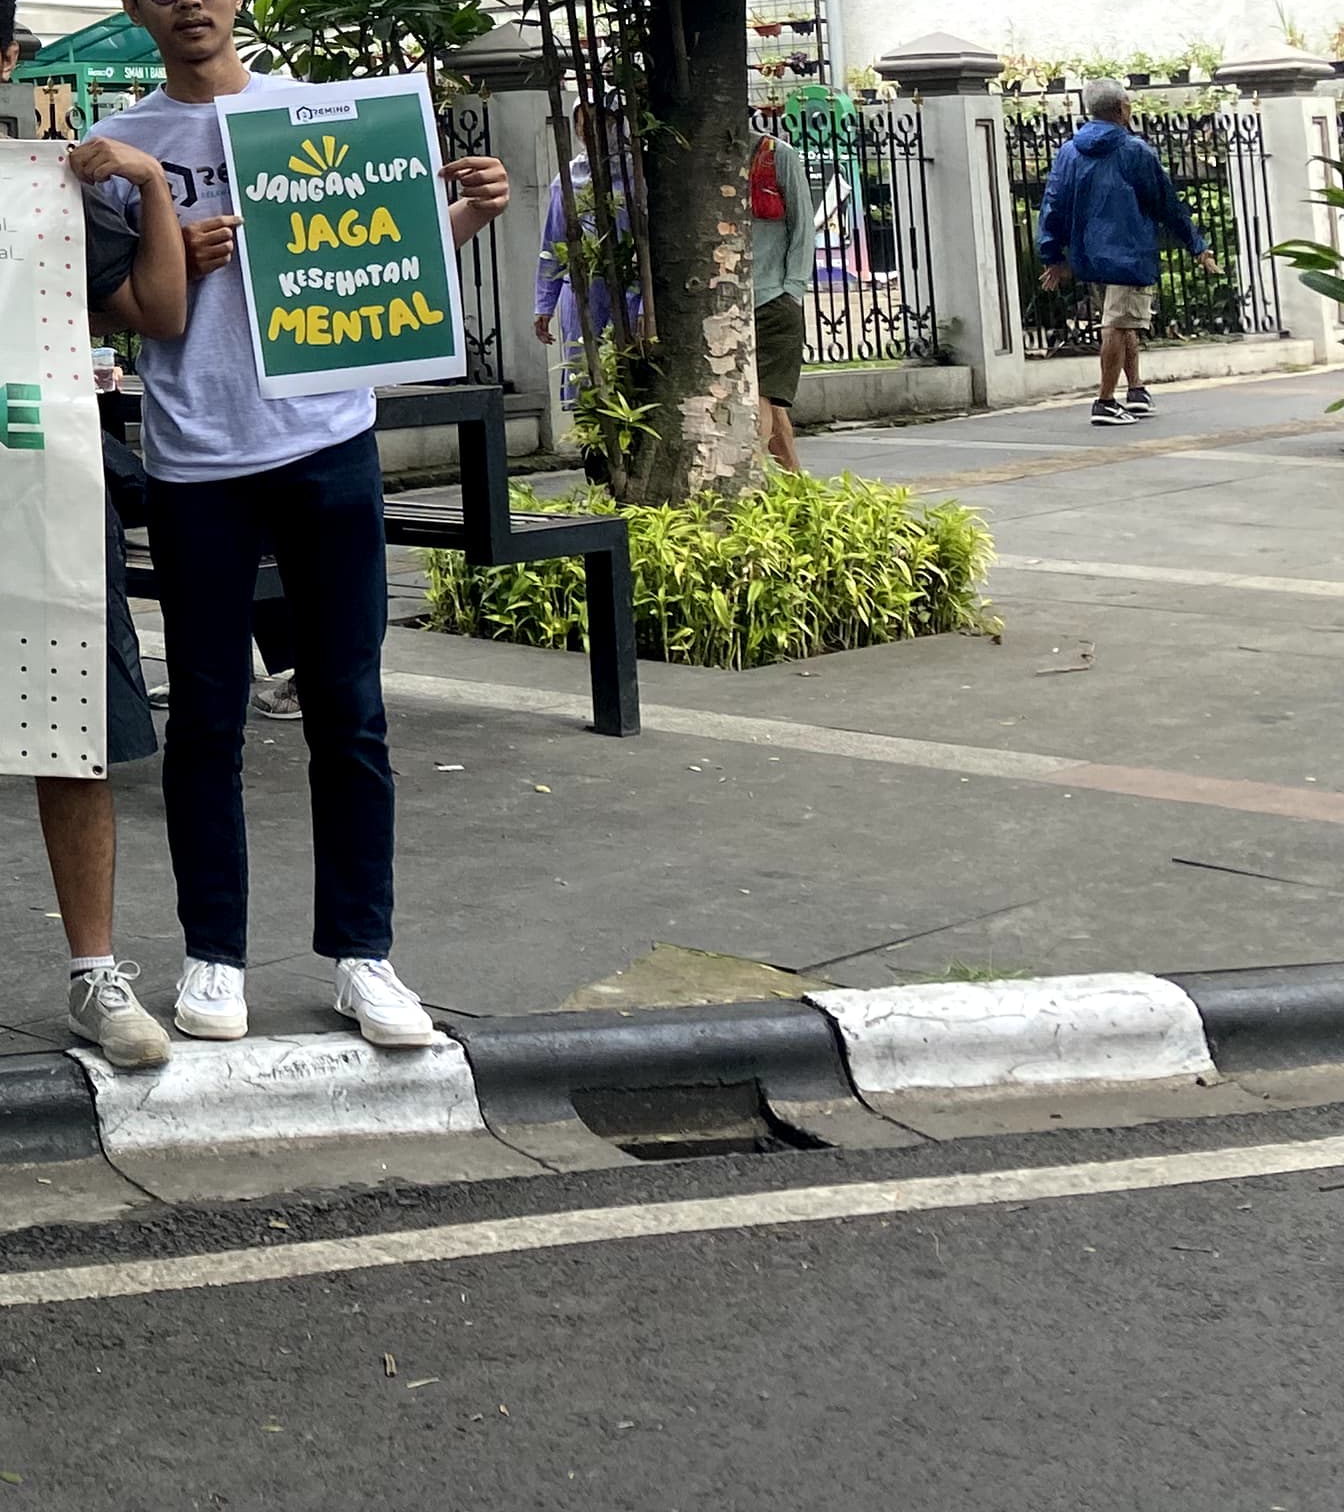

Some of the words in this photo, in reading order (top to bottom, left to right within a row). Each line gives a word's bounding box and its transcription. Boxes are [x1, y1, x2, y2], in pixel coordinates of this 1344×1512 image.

[245, 171, 366, 203] JANGAN
[365, 156, 428, 183] LUPA
[287, 206, 401, 254] JAGA
[278, 256, 420, 297] KESEHATAN
[267, 291, 443, 345] MENTAL
